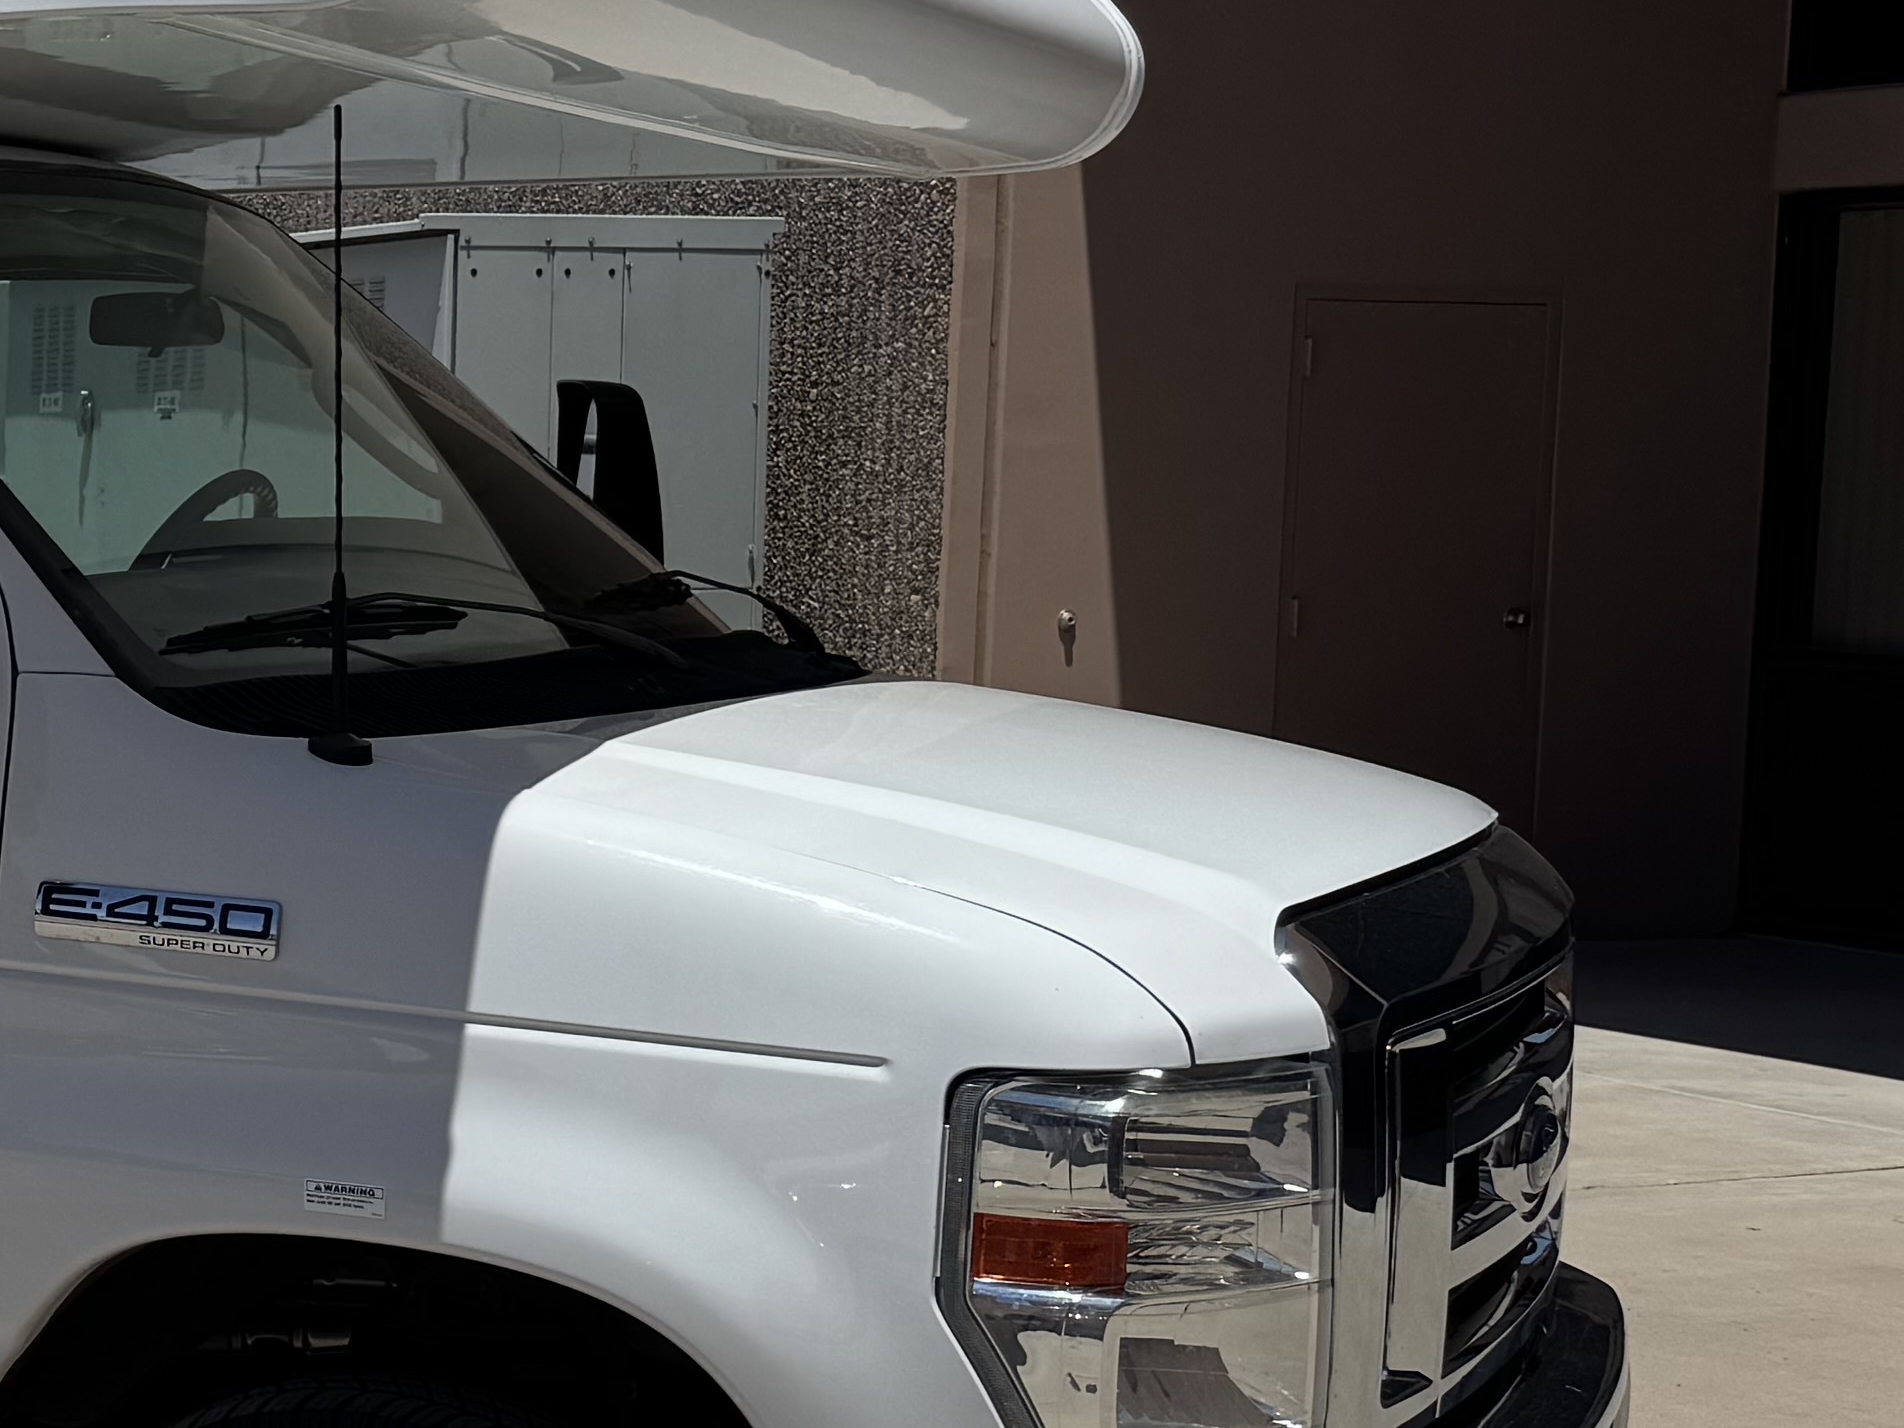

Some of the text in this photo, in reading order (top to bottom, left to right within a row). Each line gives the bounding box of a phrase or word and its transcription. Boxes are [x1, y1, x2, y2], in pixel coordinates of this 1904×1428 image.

[43, 887, 274, 940] E-450
[138, 934, 269, 957] SUPER DUTY
